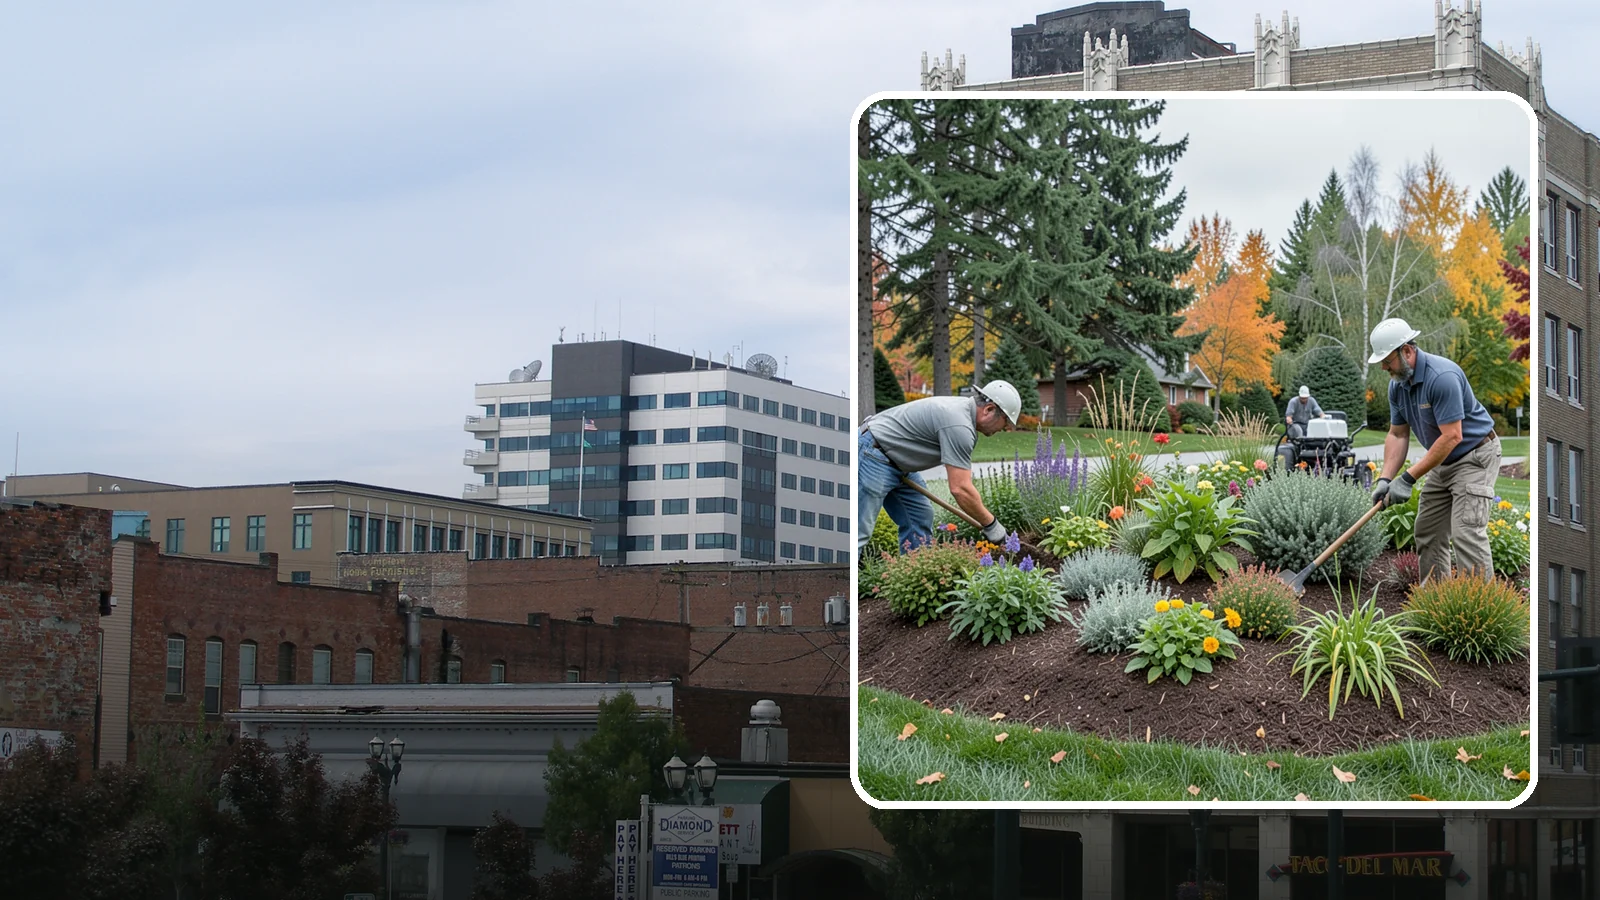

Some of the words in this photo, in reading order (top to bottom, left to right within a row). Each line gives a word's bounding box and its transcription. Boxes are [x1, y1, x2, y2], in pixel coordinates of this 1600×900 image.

[371, 566, 427, 577] Furnishers
[660, 818, 713, 832] DIAMOND
[1021, 815, 1070, 828] BUILDING
[617, 824, 625, 852] PAY
[628, 824, 637, 852] PAY
[656, 845, 688, 853] RESERVED
[689, 846, 716, 854] PARKING
[671, 862, 701, 870] PATRONS
[1346, 857, 1385, 876] DEL
[1392, 857, 1443, 877] MAR
[616, 856, 625, 894] HERE
[628, 856, 636, 893] HERE
[660, 888, 682, 897] PUBLIC
[684, 889, 710, 898] PARKING
